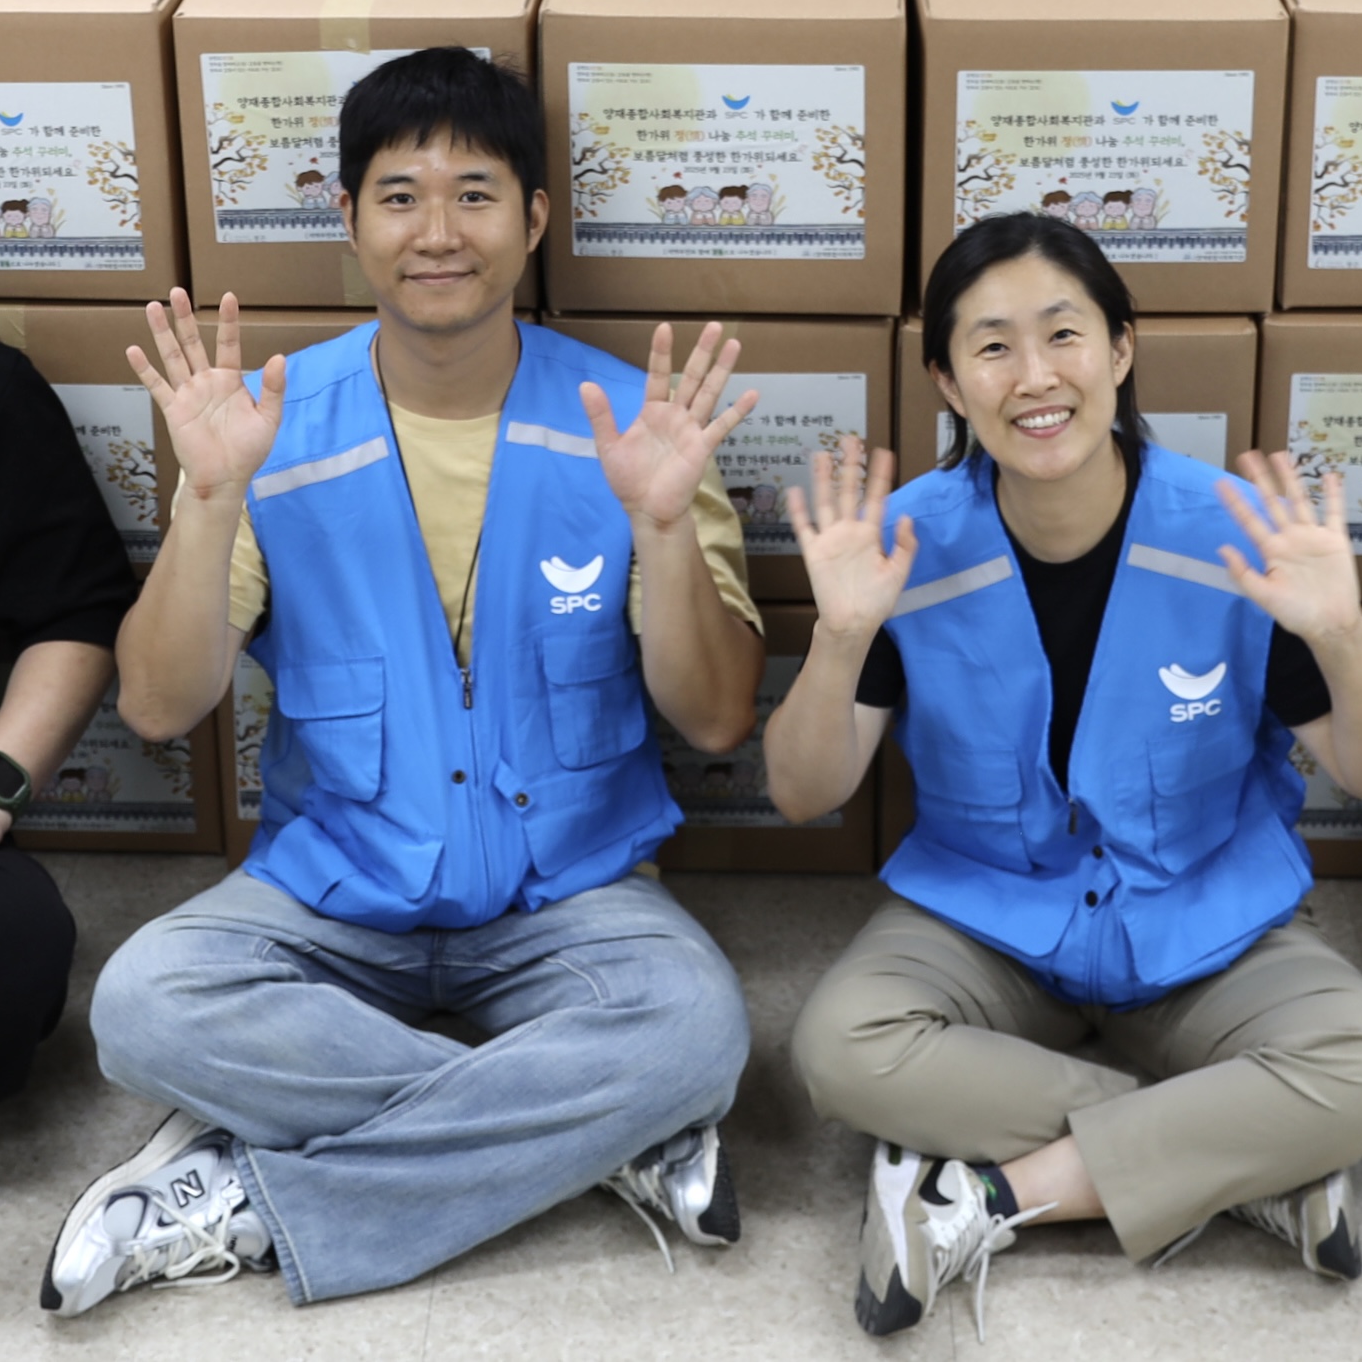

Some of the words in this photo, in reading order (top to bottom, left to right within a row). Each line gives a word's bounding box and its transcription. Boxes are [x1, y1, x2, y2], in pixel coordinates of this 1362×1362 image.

[602, 107, 718, 121] 양재종합사회복지관과
[723, 110, 749, 119] SPC
[754, 108, 766, 120] 가
[768, 108, 792, 122] 함께
[796, 108, 831, 122] 준비한
[270, 115, 305, 129] 한가위
[0, 127, 24, 136] SPC
[28, 125, 40, 137] 가
[42, 125, 65, 138] 함께
[68, 125, 102, 138] 준비한
[635, 128, 670, 142] 한가위
[707, 129, 732, 142] 나눔
[734, 129, 757, 142] 추석
[11, 145, 34, 157] 추석
[692, 150, 727, 163] 풍성한
[549, 593, 602, 615] SPC
[1169, 699, 1222, 723] SPC
[170, 1169, 205, 1208] N
